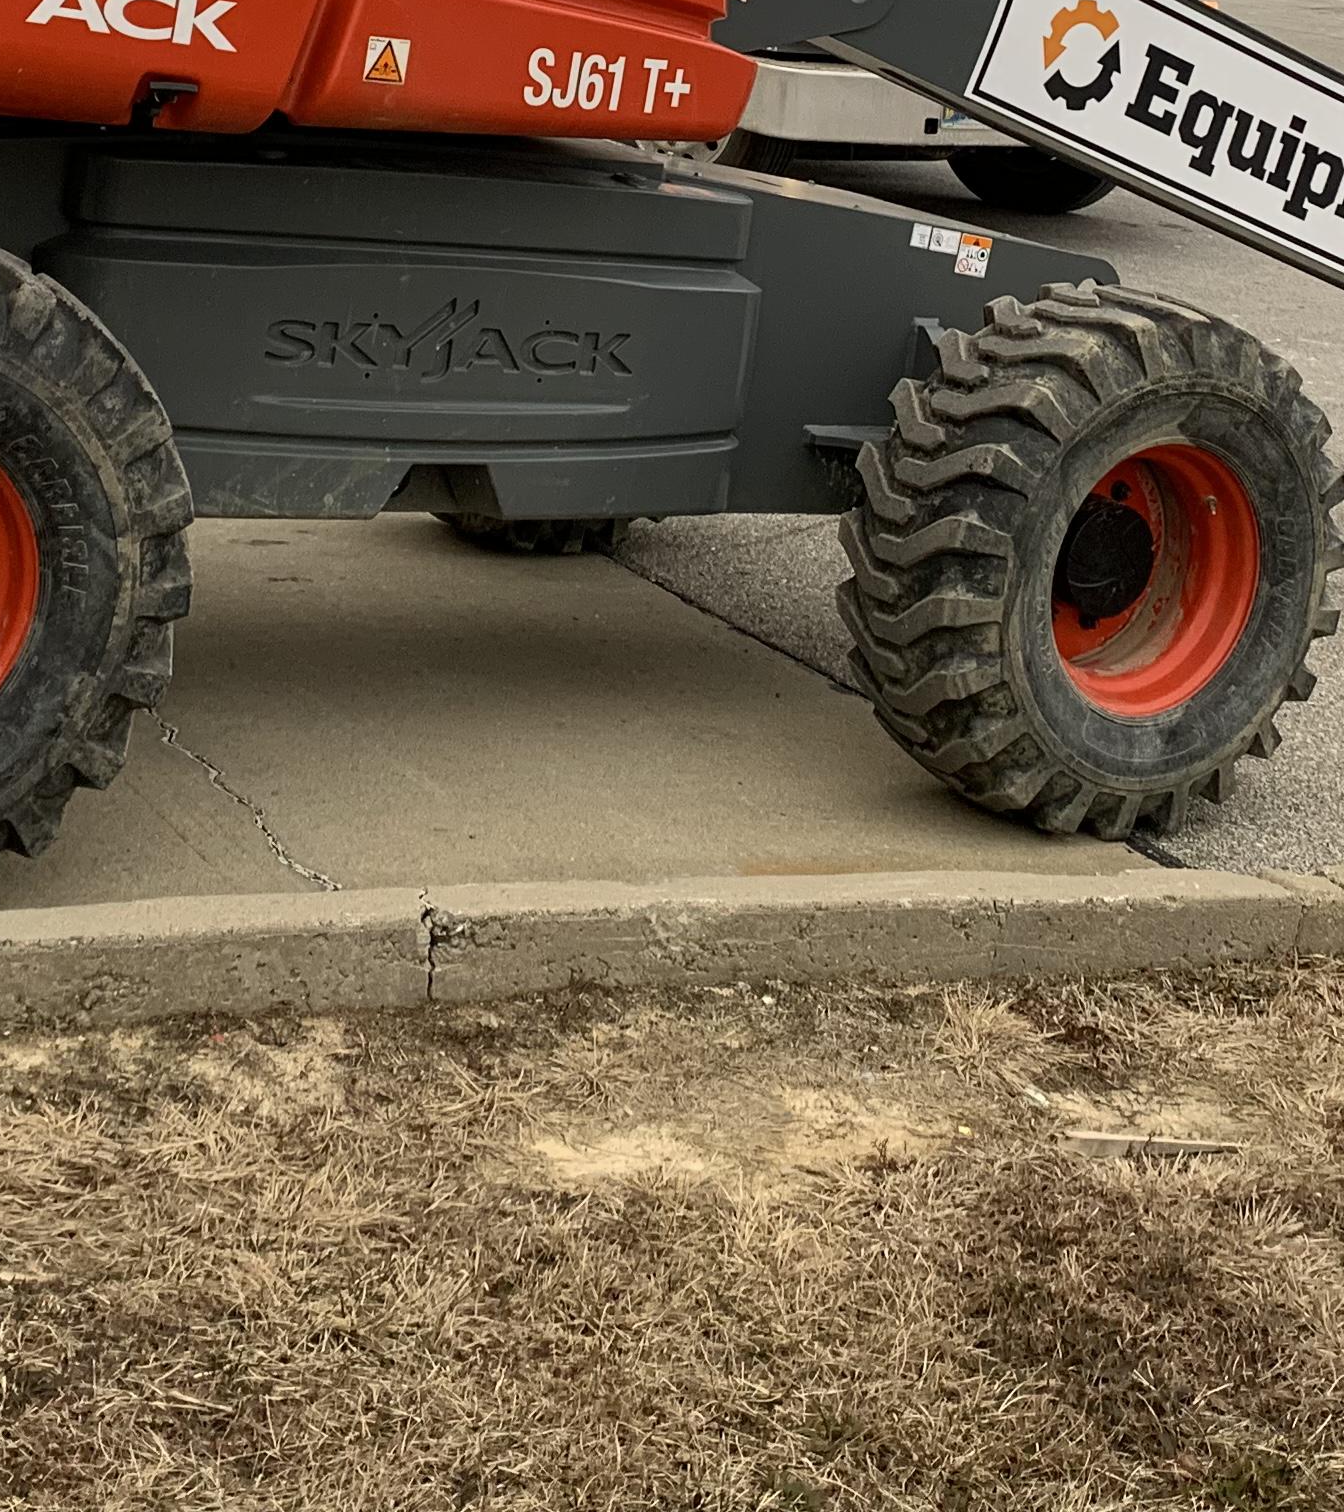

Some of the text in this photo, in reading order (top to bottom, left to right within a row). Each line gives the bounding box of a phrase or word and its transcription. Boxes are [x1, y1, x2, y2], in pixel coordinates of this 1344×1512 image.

[523, 46, 692, 114] SJ61 T+
[263, 296, 635, 384] SKYJACK
